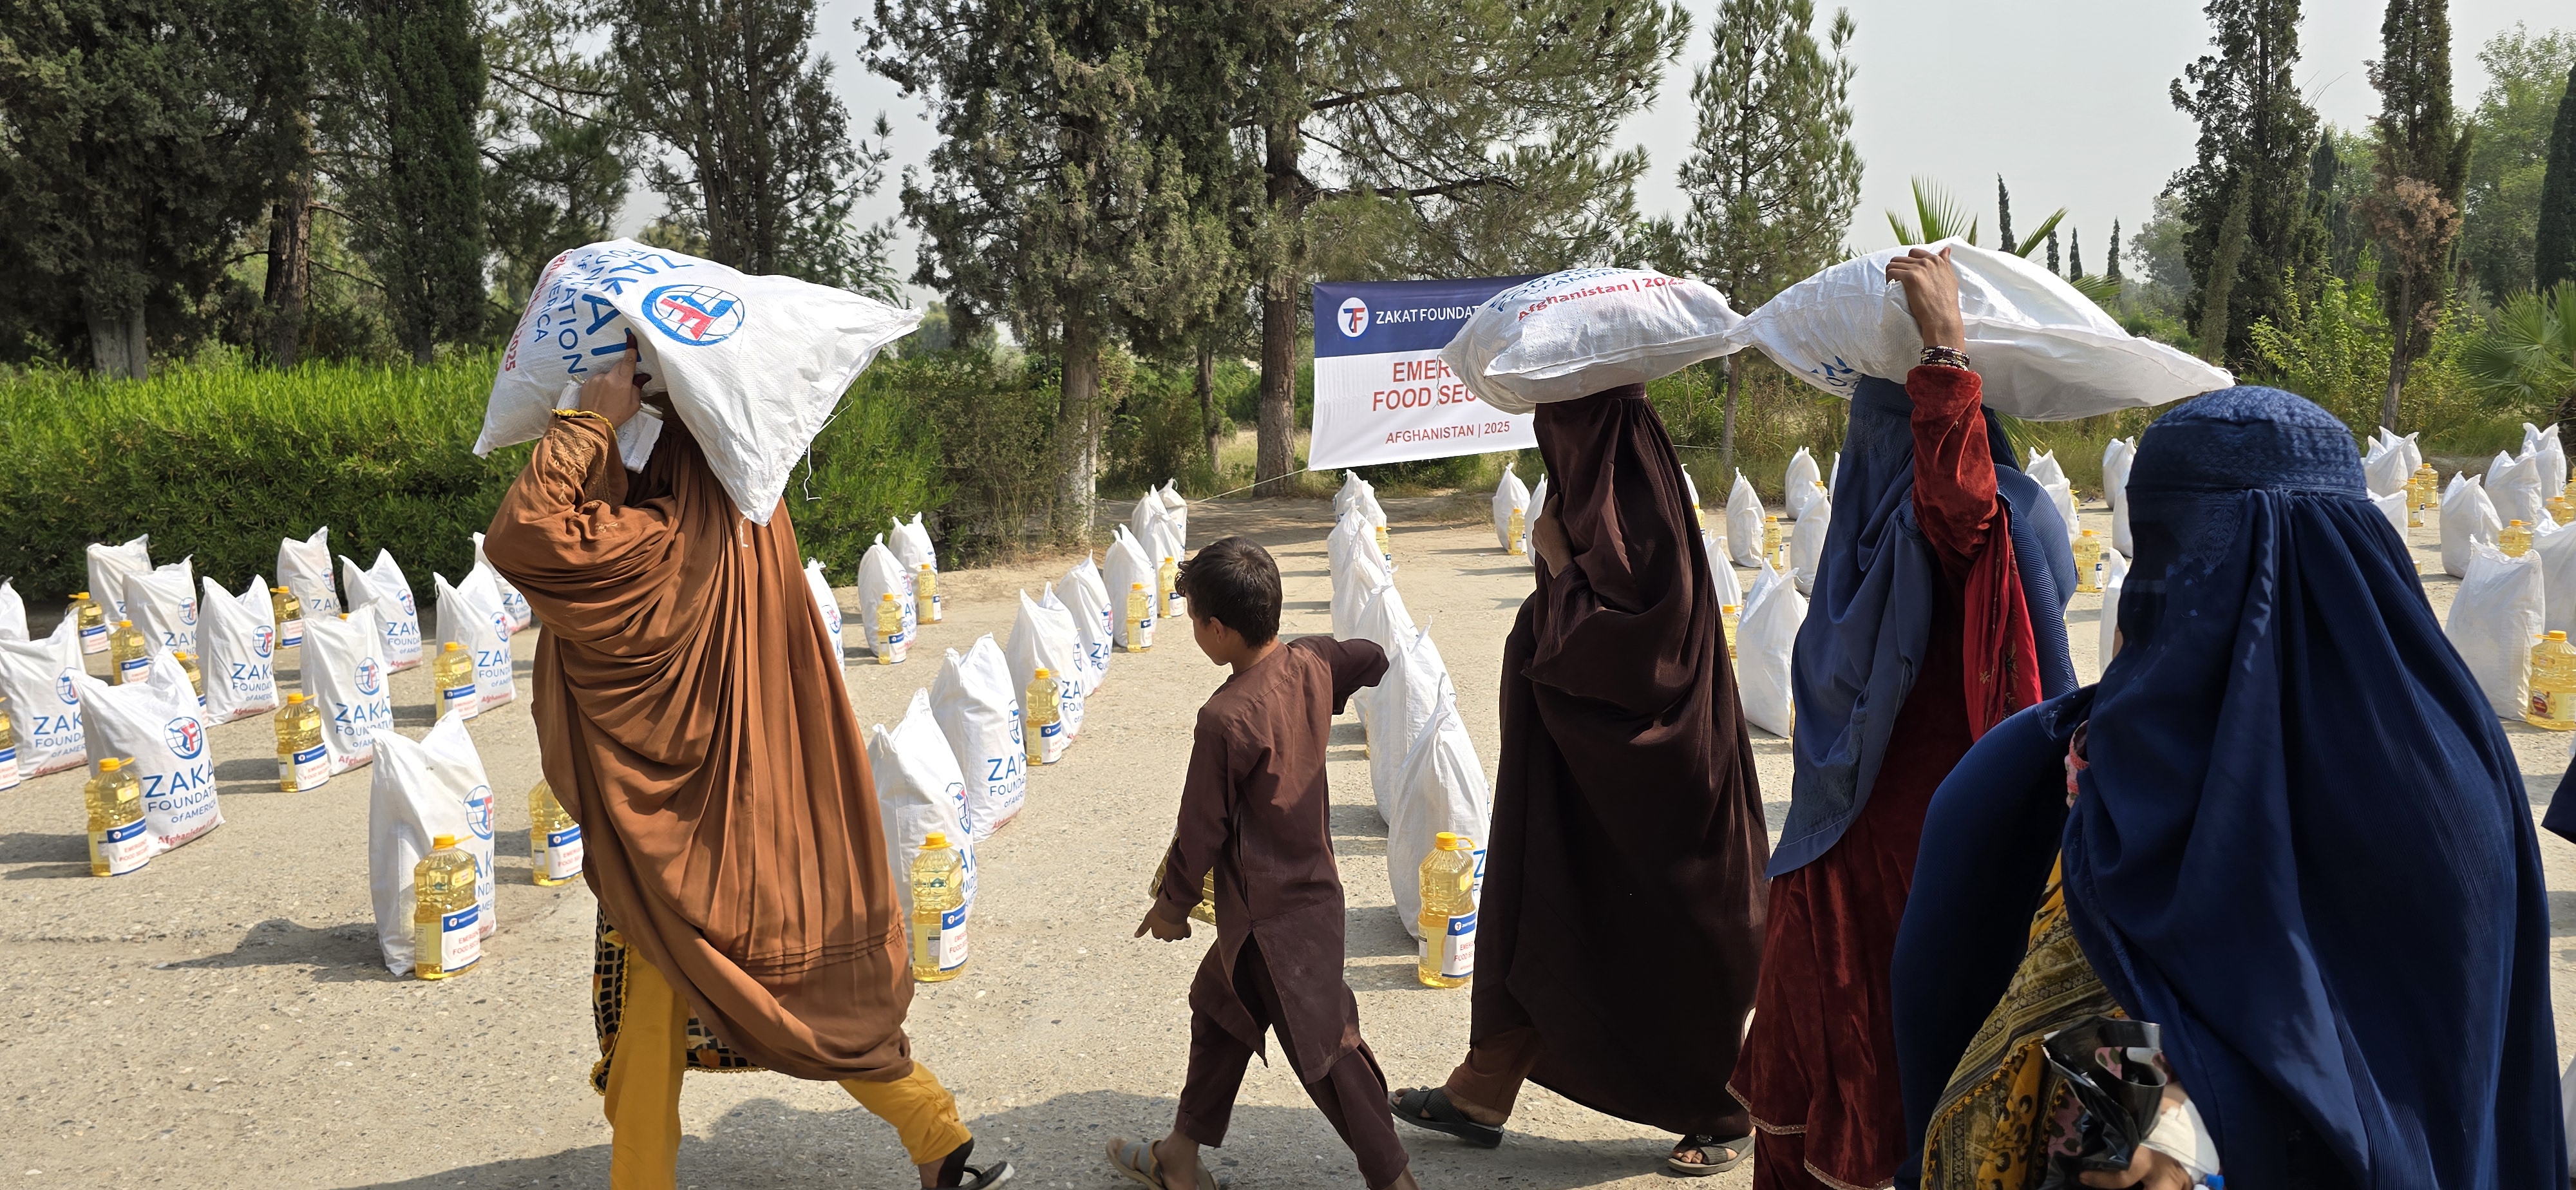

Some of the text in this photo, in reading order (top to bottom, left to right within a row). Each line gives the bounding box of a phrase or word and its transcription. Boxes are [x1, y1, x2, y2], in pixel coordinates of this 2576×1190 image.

[1518, 283, 1629, 322] Afghanistan
[1376, 309, 1418, 325] ZAKAT
[505, 330, 523, 372] 2025
[1393, 359, 1458, 382] EMER
[1372, 387, 1432, 411] FOOD
[1385, 424, 1474, 444] AFGHANISTAN
[1484, 421, 1510, 435] 2025
[477, 647, 512, 667] ZAK
[335, 696, 390, 724] ZAKA
[33, 712, 84, 735] ZAK
[171, 813, 183, 824] of
